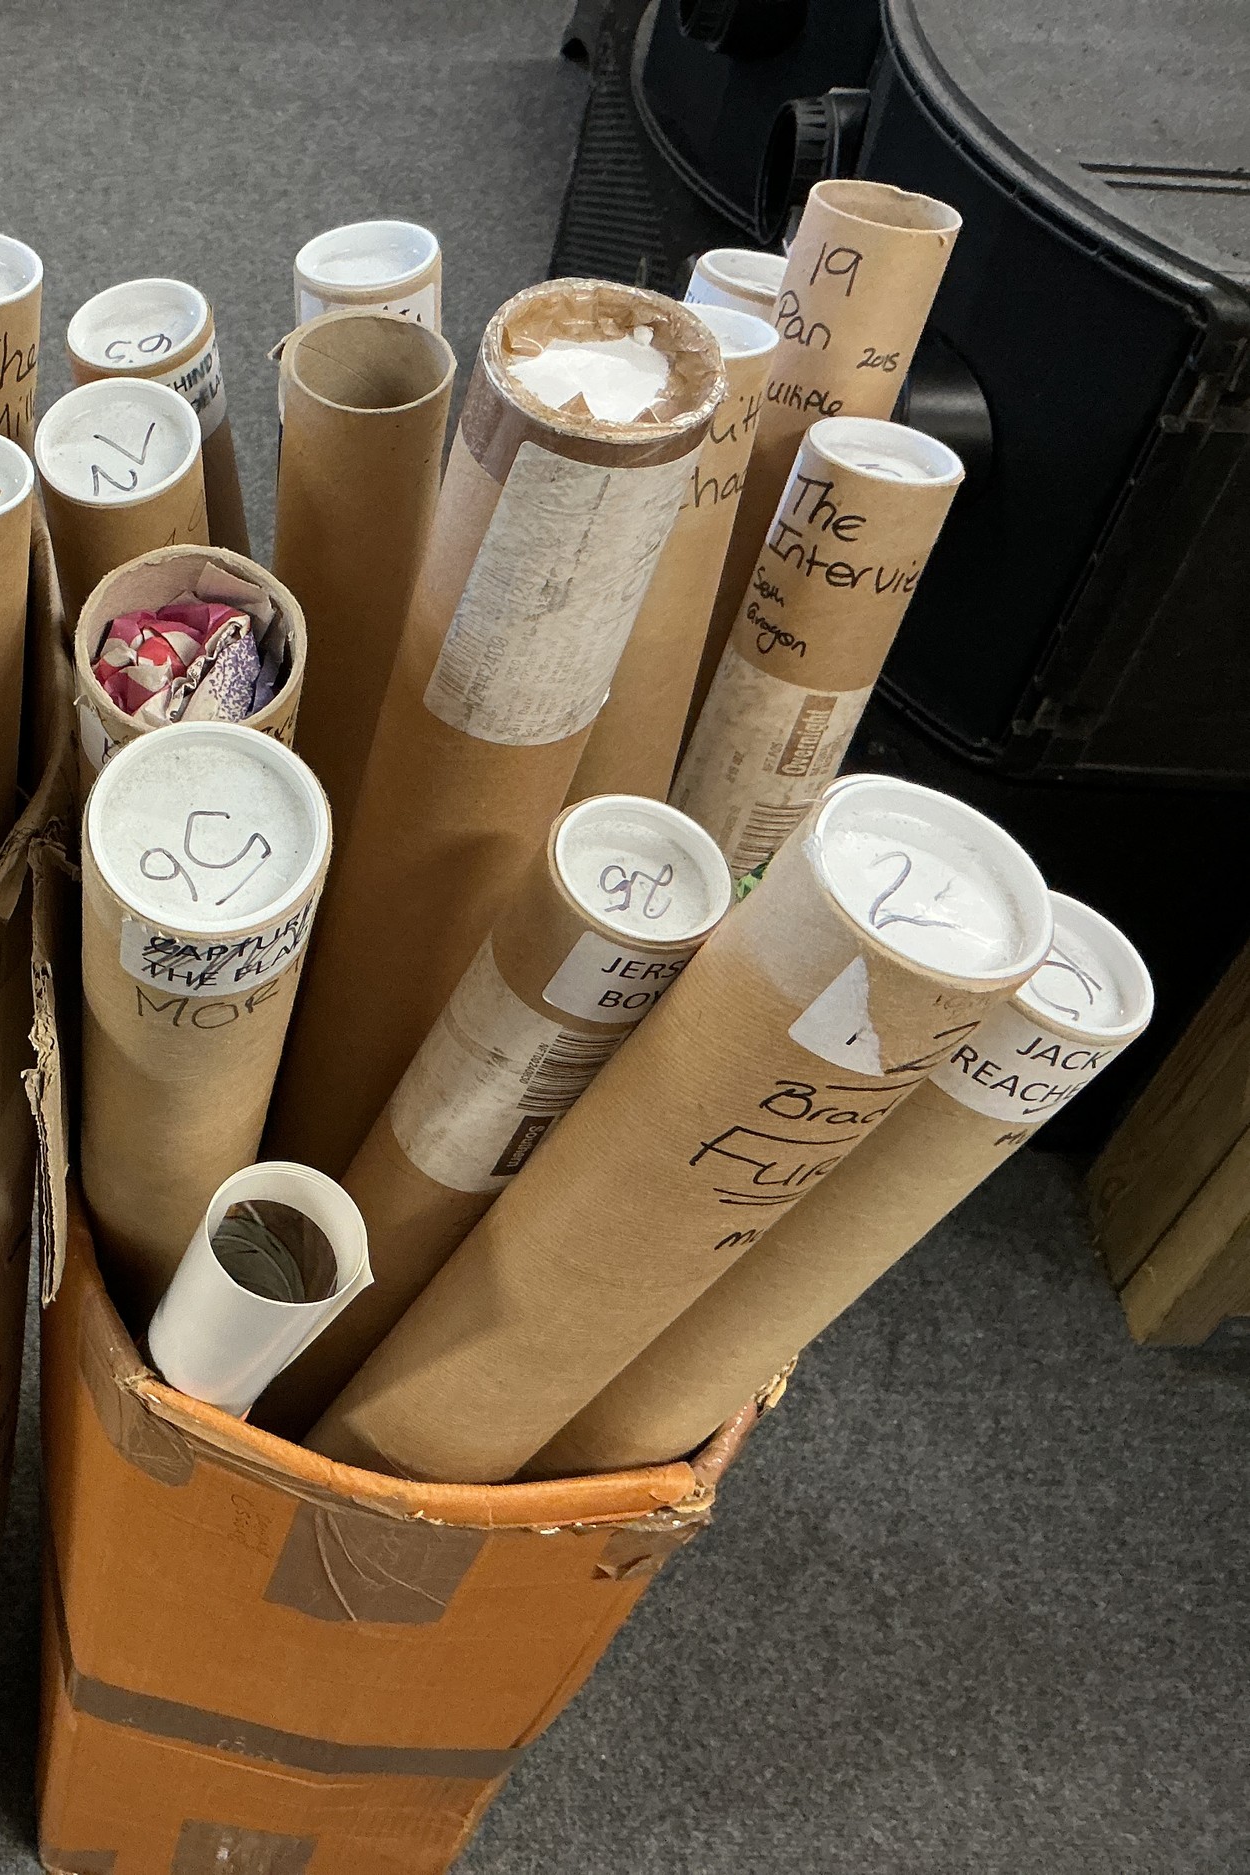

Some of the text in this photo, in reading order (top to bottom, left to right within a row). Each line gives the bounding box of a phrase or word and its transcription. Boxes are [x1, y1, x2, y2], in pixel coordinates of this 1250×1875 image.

[809, 242, 863, 297] 19
[777, 291, 831, 350] Pan
[857, 346, 900, 372] 2015
[796, 473, 867, 543] The
[782, 709, 831, 775] Overnight
[599, 864, 673, 919] 25
[1016, 1036, 1112, 1071] JACK
